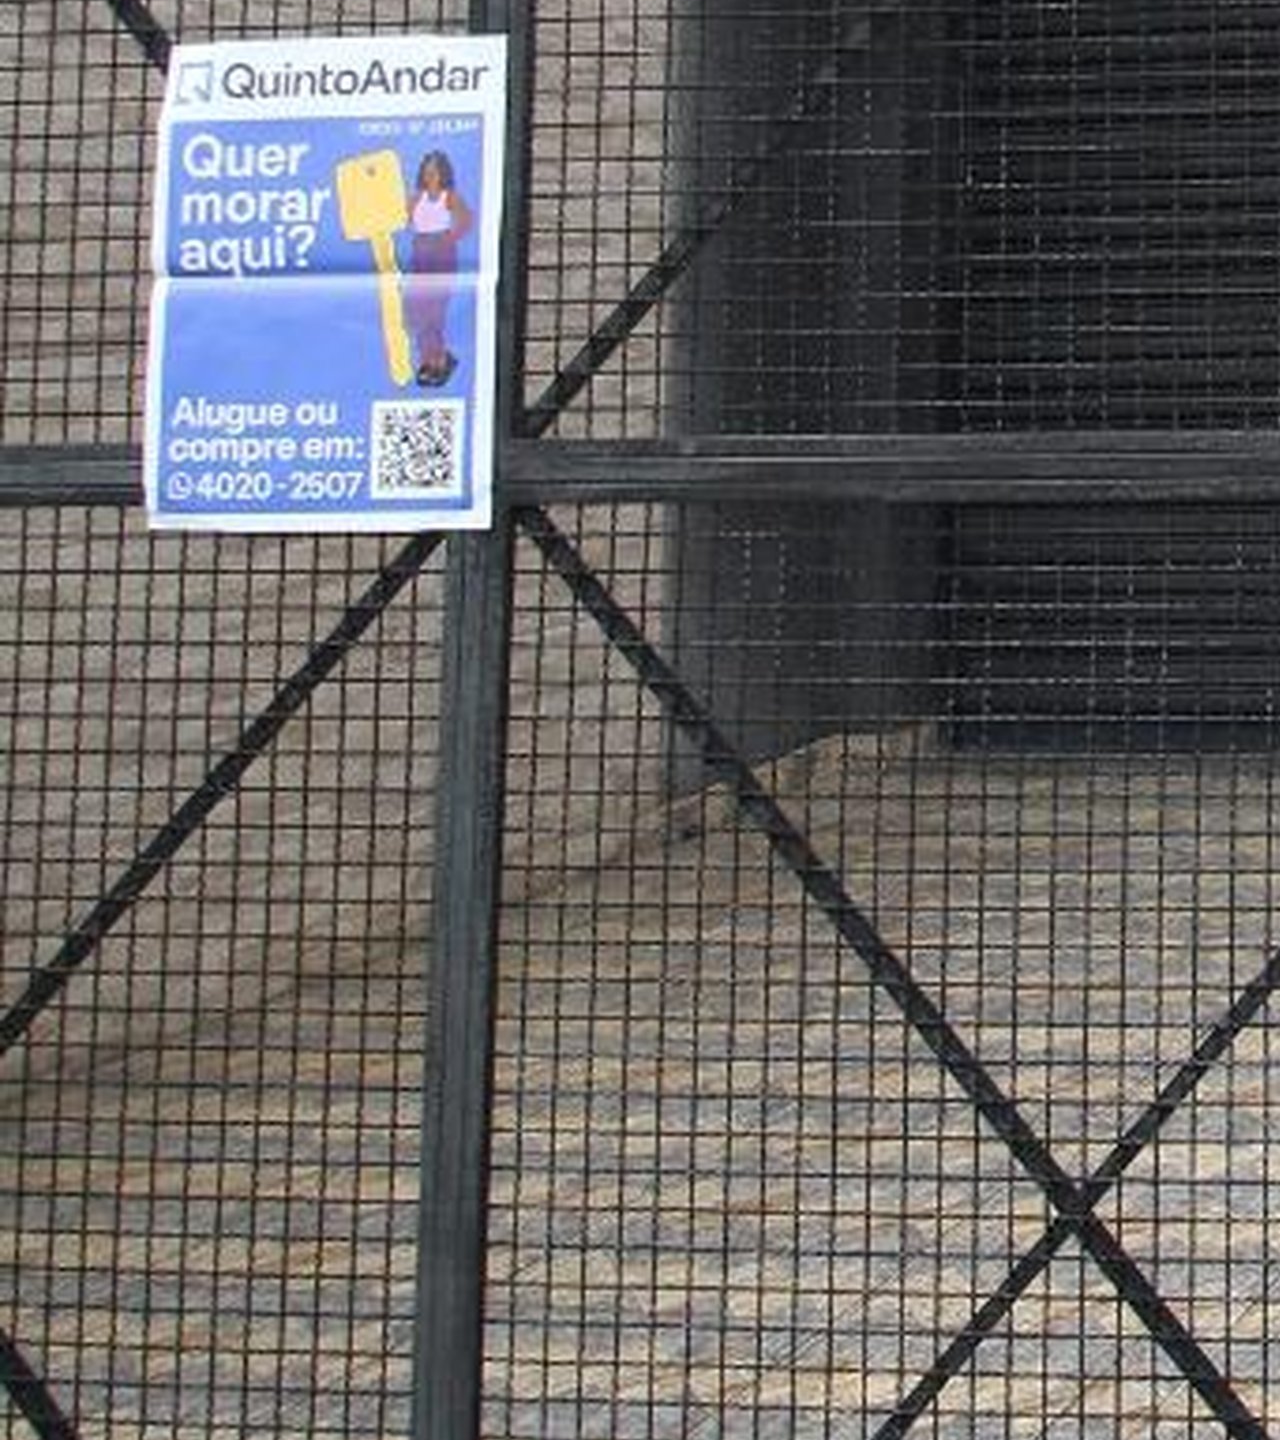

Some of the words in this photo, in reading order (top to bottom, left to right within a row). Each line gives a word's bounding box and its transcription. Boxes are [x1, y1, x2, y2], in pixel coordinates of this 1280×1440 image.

[222, 59, 490, 100] QuintoAndar
[182, 133, 310, 180] Quer
[181, 186, 331, 225] morar
[178, 225, 317, 277] aqui?
[171, 396, 290, 435] Alugue
[295, 401, 339, 426] ou
[167, 436, 298, 467] compre
[301, 435, 366, 461] em:
